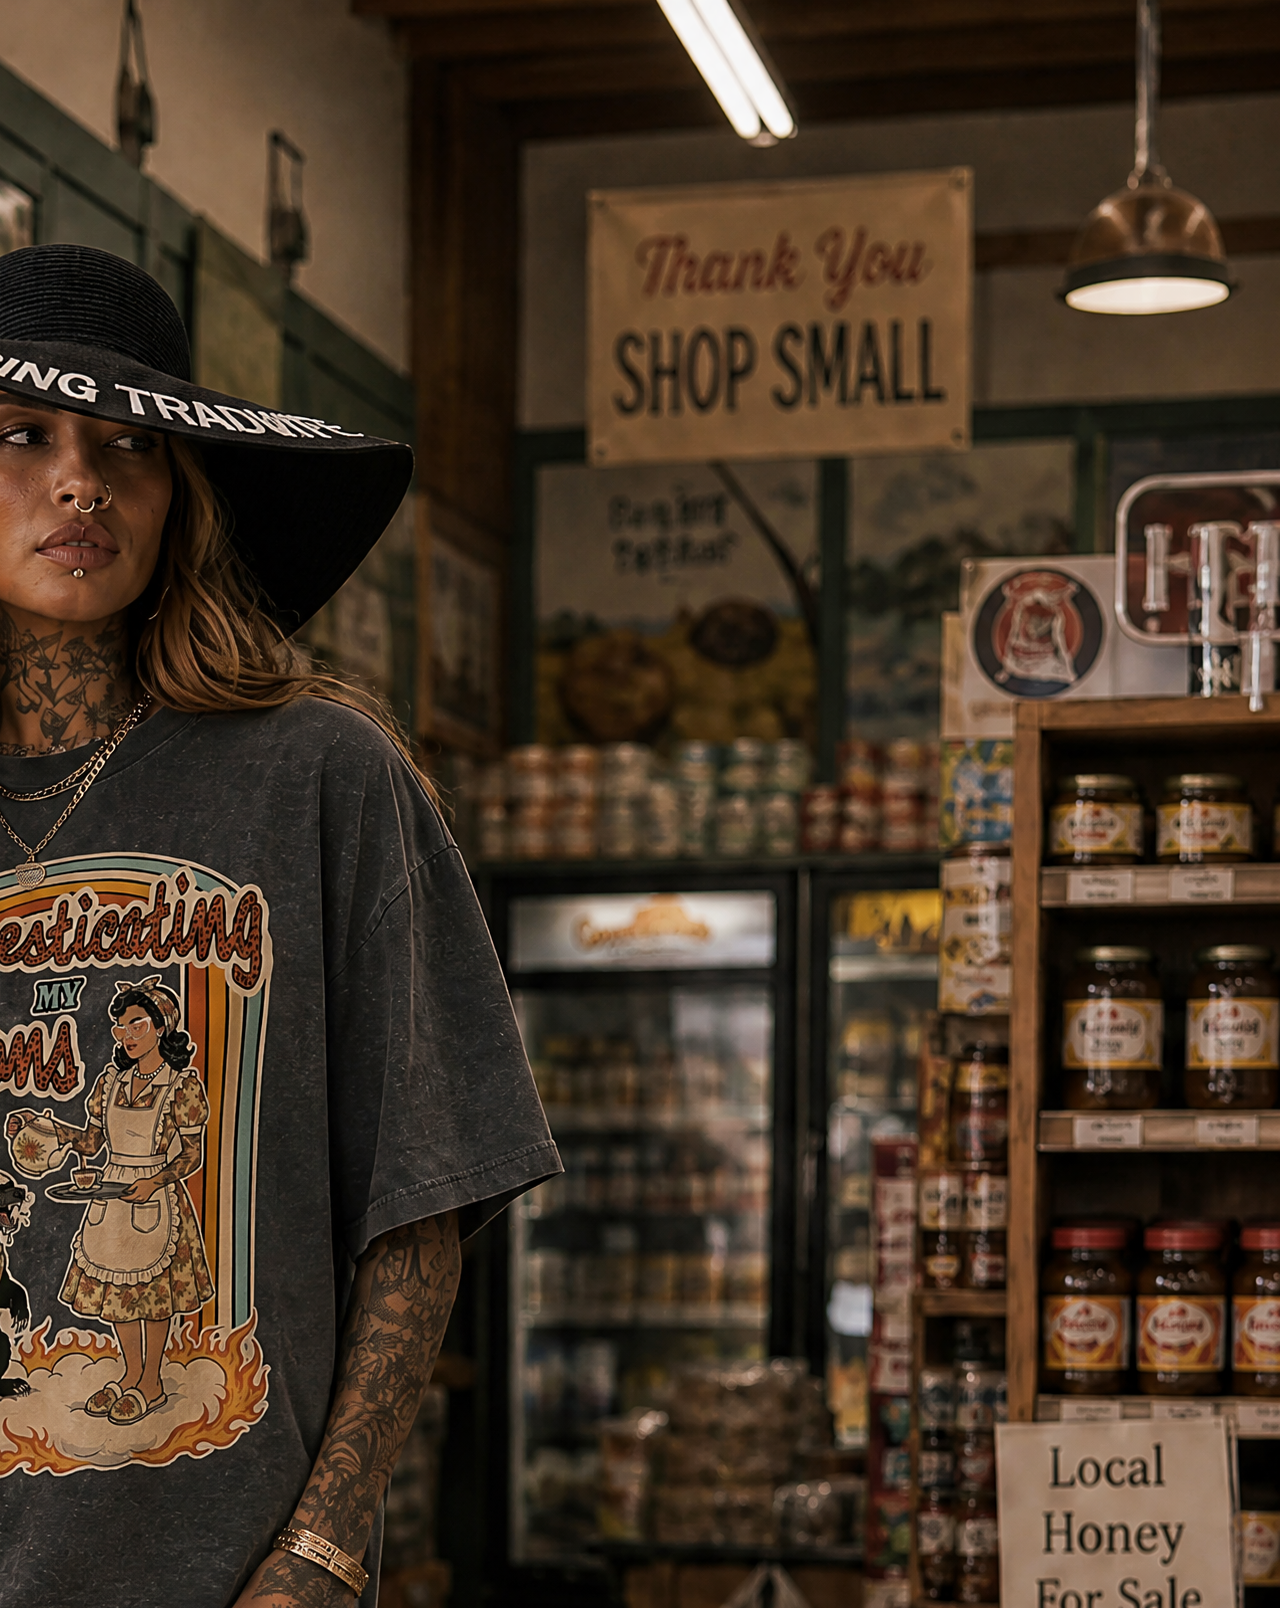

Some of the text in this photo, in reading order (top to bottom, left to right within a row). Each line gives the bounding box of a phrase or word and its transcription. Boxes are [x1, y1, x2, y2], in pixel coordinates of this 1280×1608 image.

[634, 224, 932, 312] Thank You
[613, 320, 947, 418] SHOP SMALL
[35, 979, 83, 1012] MY
[1048, 1442, 1166, 1489] Local
[1041, 1510, 1185, 1566] Honey
